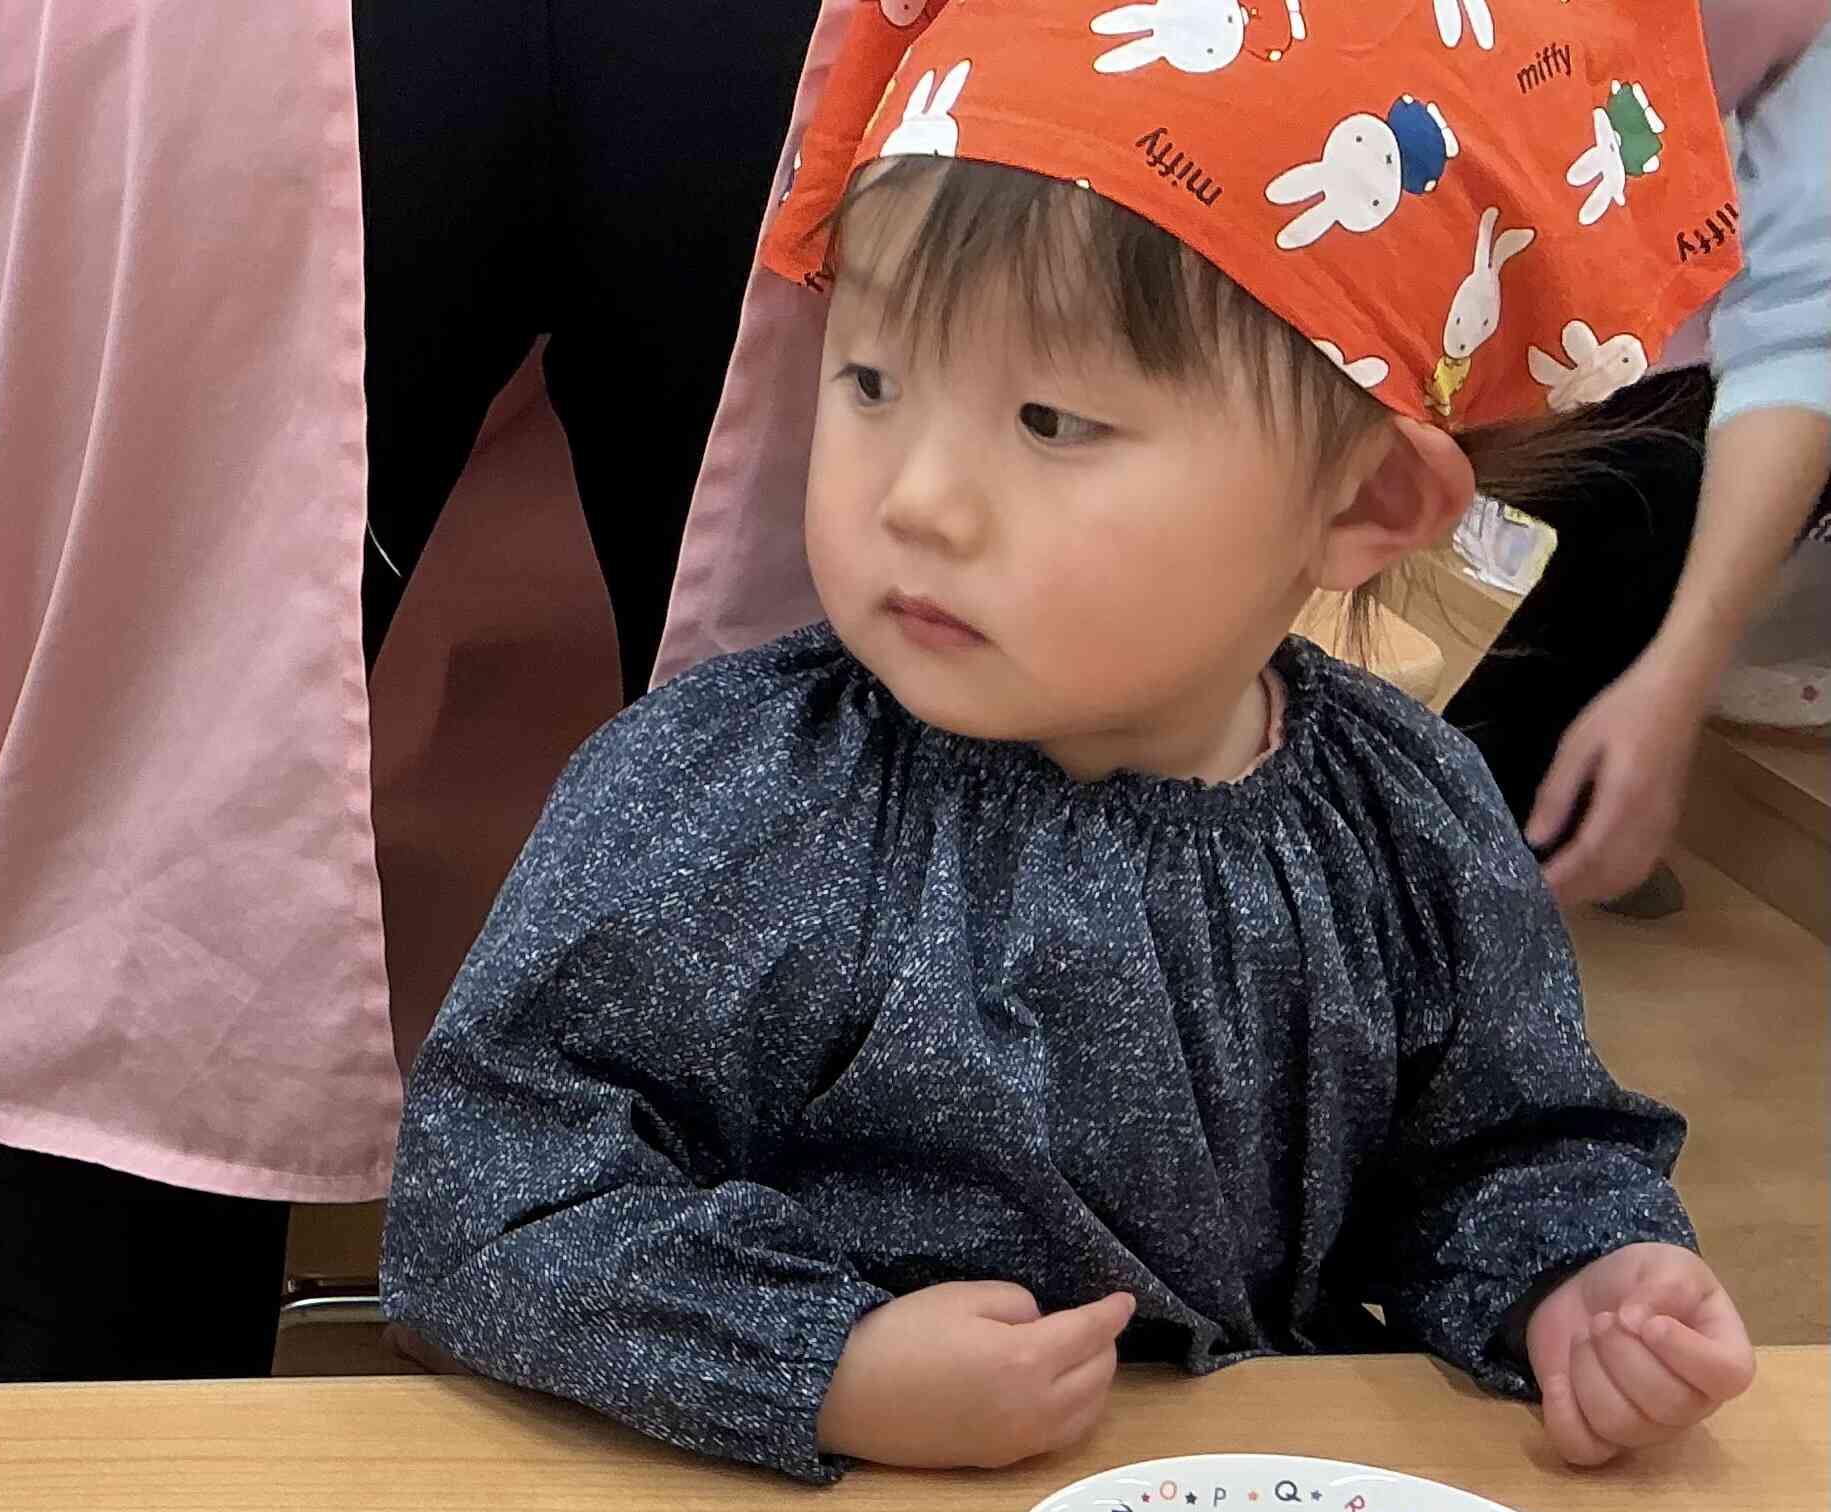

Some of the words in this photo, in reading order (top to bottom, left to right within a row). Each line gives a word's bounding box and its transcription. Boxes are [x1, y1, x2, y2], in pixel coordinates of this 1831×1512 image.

[1517, 43, 1571, 94] miffy
[1135, 128, 1223, 206] miffy
[1160, 1479, 1177, 1500] O
[1214, 1488, 1226, 1506] P
[1275, 1480, 1302, 1503] Q
